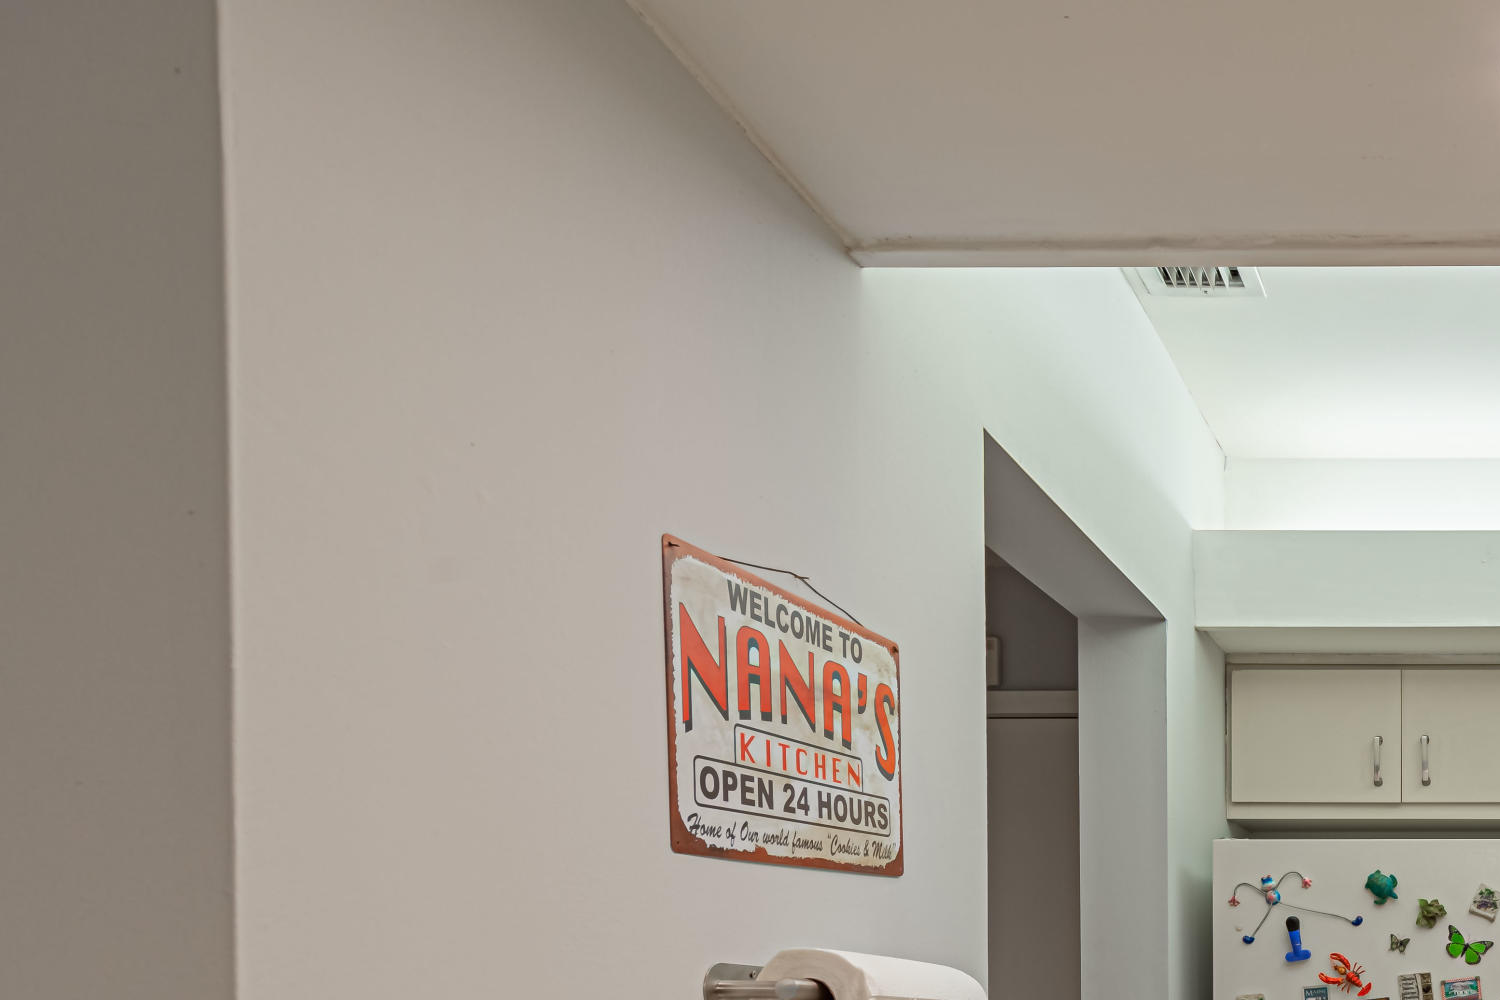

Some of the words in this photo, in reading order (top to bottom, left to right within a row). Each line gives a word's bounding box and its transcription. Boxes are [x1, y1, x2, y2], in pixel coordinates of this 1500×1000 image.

[727, 578, 833, 652] WELCOME
[839, 630, 864, 664] TO
[678, 601, 897, 782] NANA'S
[739, 731, 863, 790] KITCHEN
[699, 765, 775, 811] OPEN
[782, 783, 810, 817] 24
[817, 790, 889, 831] HOURS
[687, 812, 722, 838] Home
[725, 821, 737, 847] of
[740, 820, 759, 843] Our
[762, 828, 790, 848] world
[792, 831, 824, 854] famous
